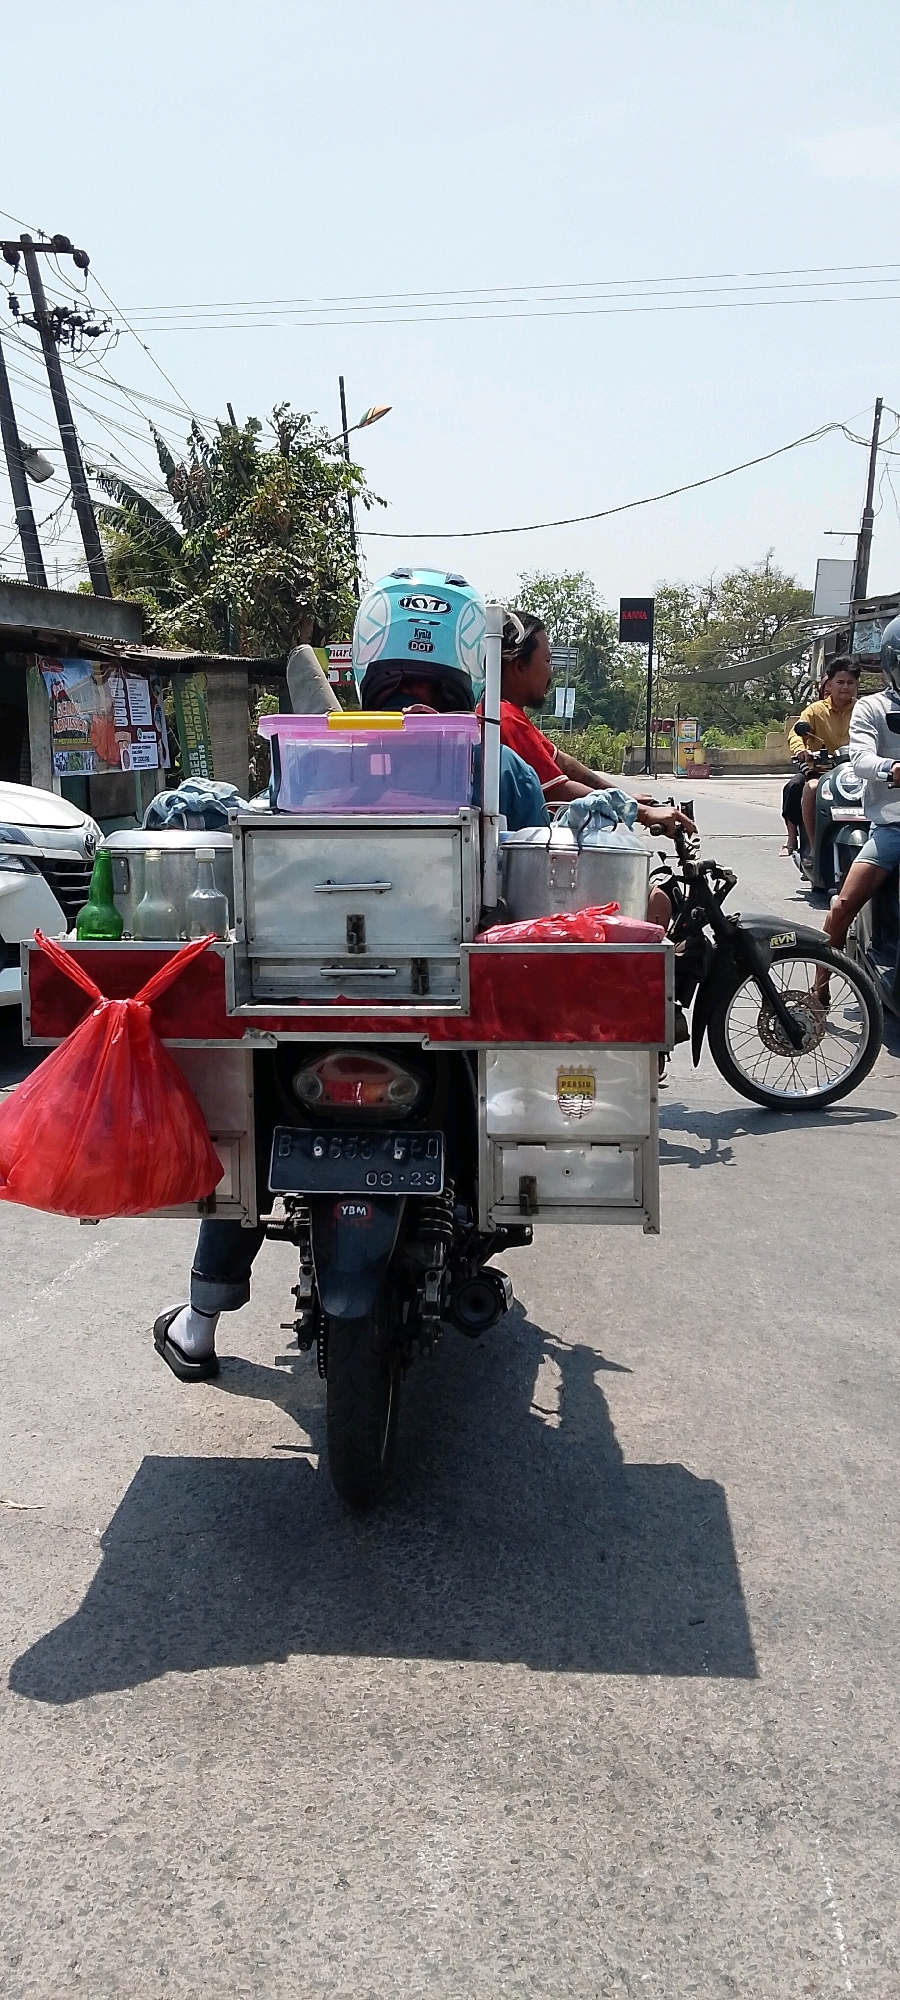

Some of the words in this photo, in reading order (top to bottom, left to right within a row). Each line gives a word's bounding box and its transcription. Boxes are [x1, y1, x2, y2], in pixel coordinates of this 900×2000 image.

[410, 641, 432, 652] DOT
[188, 751, 201, 777] GER
[198, 744, 209, 778] OOTH
[770, 933, 795, 947] RVN
[561, 1080, 592, 1088] PERSIB
[278, 1134, 292, 1157] B
[340, 1205, 367, 1216] YBM
